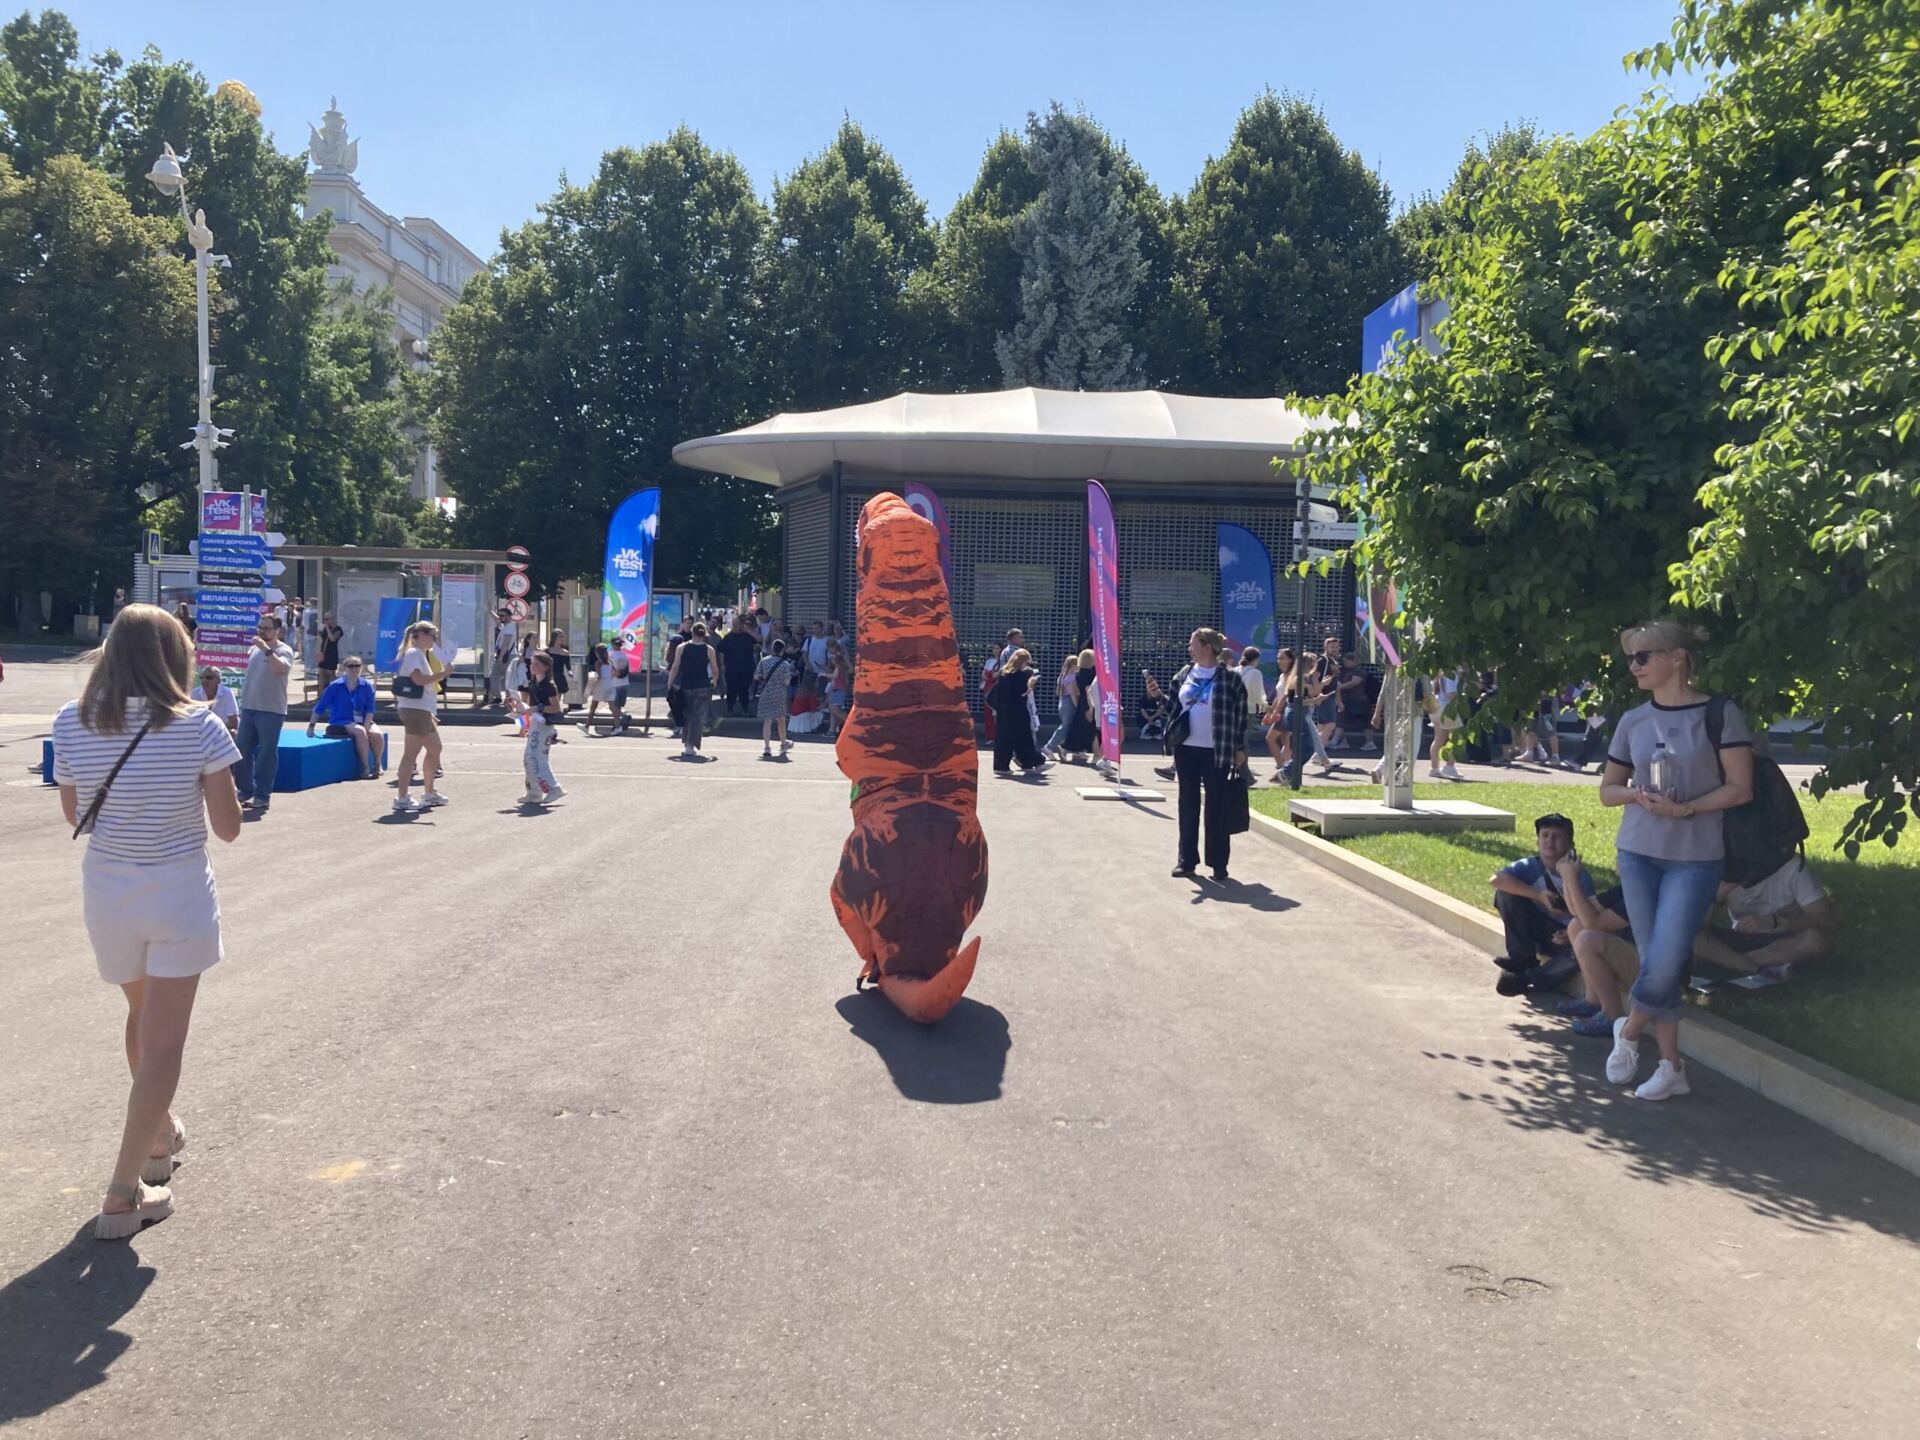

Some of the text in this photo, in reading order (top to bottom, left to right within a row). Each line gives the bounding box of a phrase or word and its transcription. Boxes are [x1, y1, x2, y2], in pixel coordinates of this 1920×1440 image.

[213, 499, 231, 507] VK
[206, 503, 239, 516] fest
[621, 548, 641, 561] VK
[202, 555, 227, 563] СИНЯЯ
[612, 554, 648, 572] fest
[213, 614, 256, 622] ЛЕКТОРИЙ
[380, 630, 397, 638] WC
